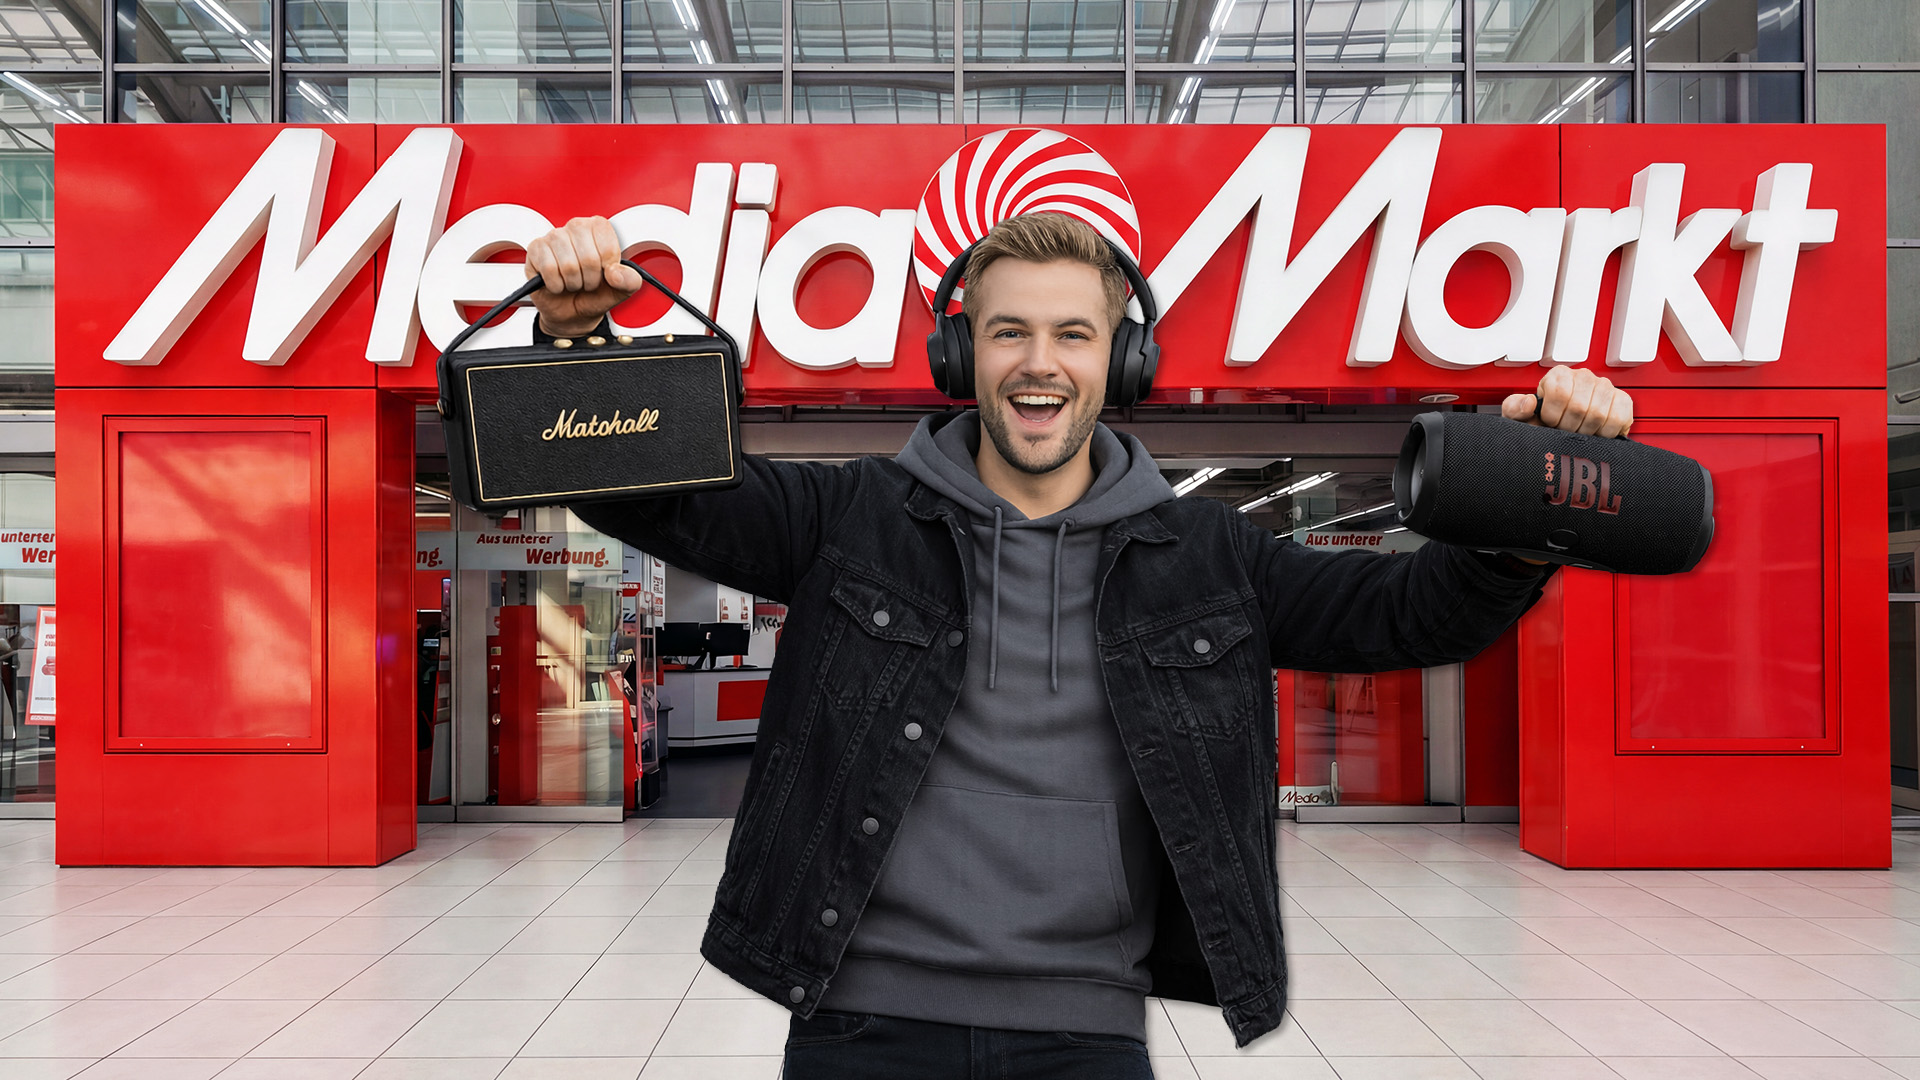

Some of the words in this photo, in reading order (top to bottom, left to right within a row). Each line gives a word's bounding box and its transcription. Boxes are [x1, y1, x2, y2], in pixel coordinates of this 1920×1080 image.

[103, 127, 917, 369] Media
[1127, 127, 1839, 369] Markt
[1545, 454, 1623, 516] JBL
[476, 533, 501, 545] Aus
[502, 533, 553, 545] unterer
[1305, 533, 1330, 546] Aus
[1331, 533, 1383, 546] unterer
[526, 547, 610, 568] Werbung.
